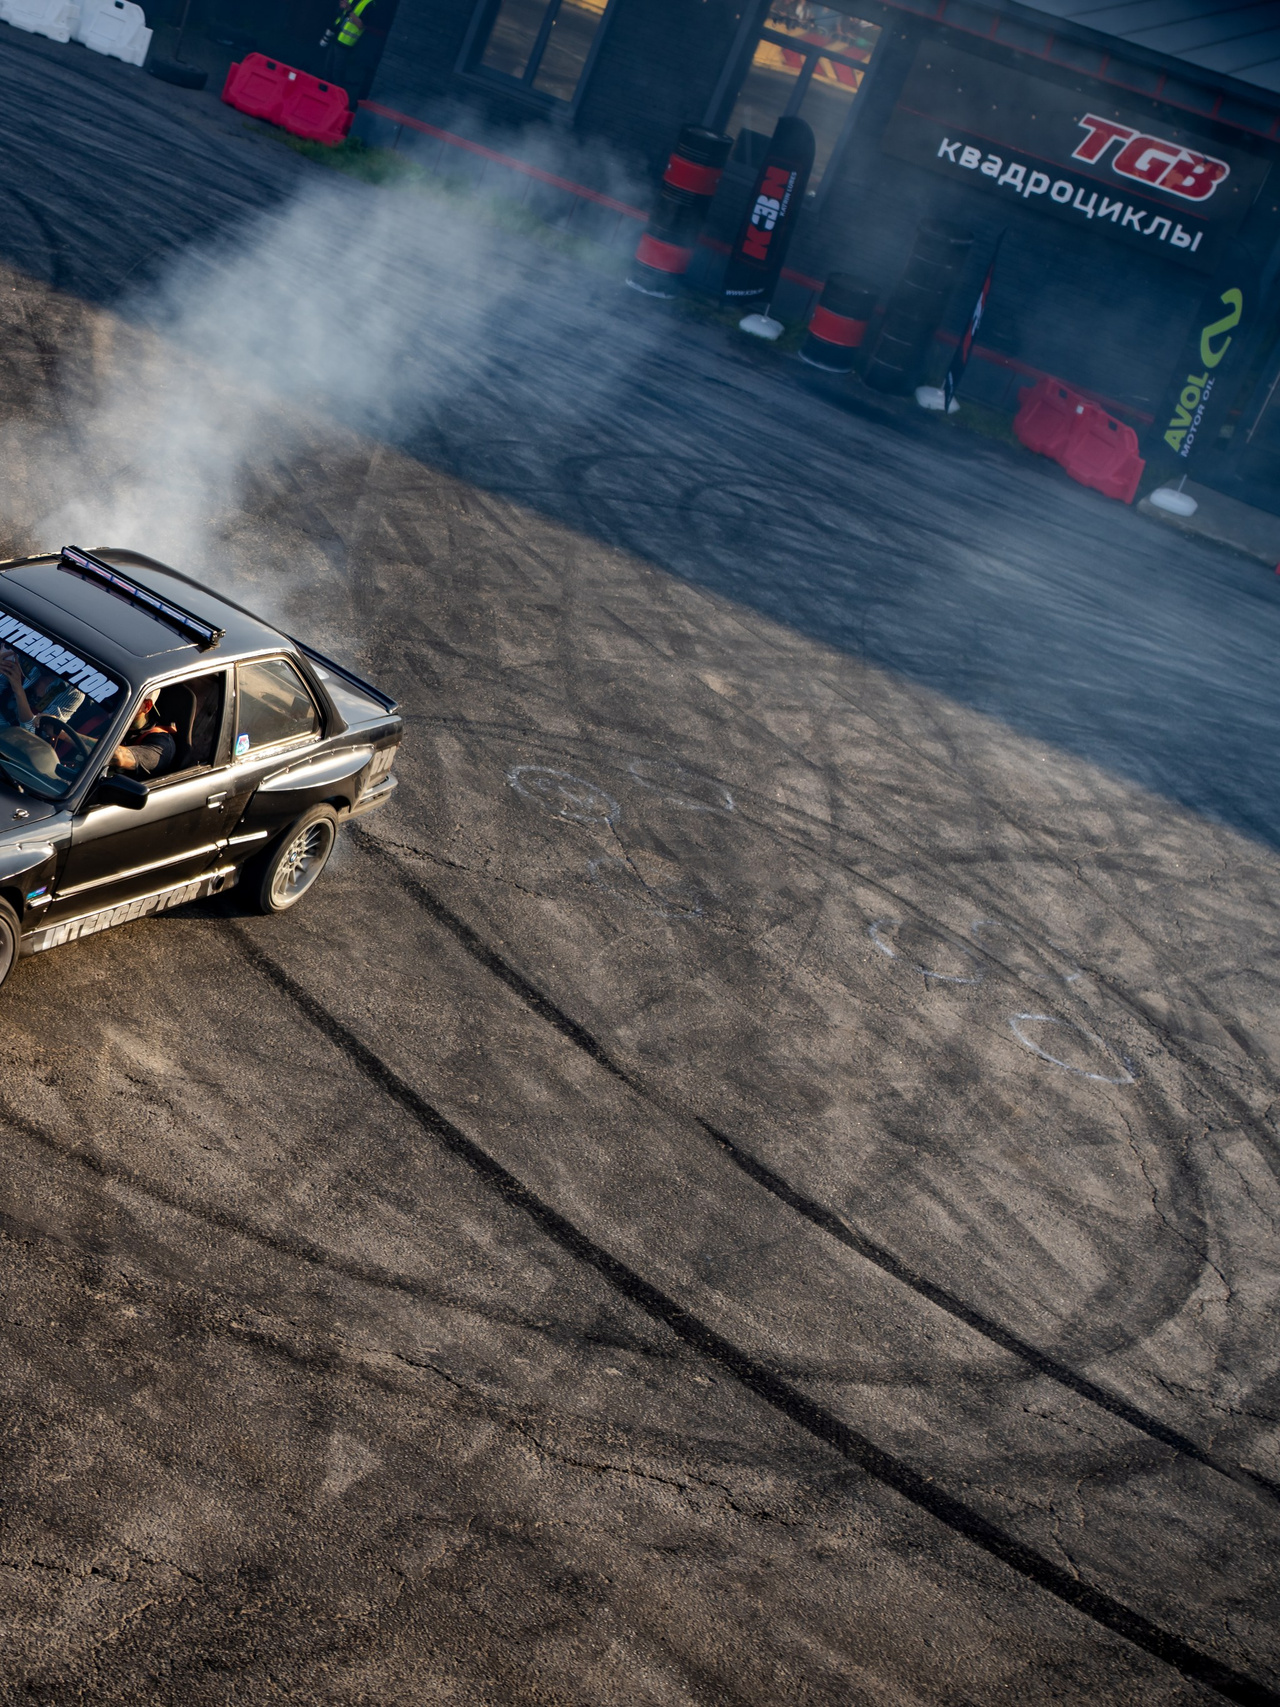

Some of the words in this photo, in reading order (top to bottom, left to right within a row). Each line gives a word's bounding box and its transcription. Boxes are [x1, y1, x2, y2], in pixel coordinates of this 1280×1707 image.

[937, 138, 1203, 252] квадроциклы
[1072, 113, 1230, 202] TGB
[1164, 372, 1209, 453] AVOL
[1181, 404, 1206, 457] MOTOR
[1203, 377, 1216, 401] OIL
[42, 882, 202, 950] INTERCEPTOR
